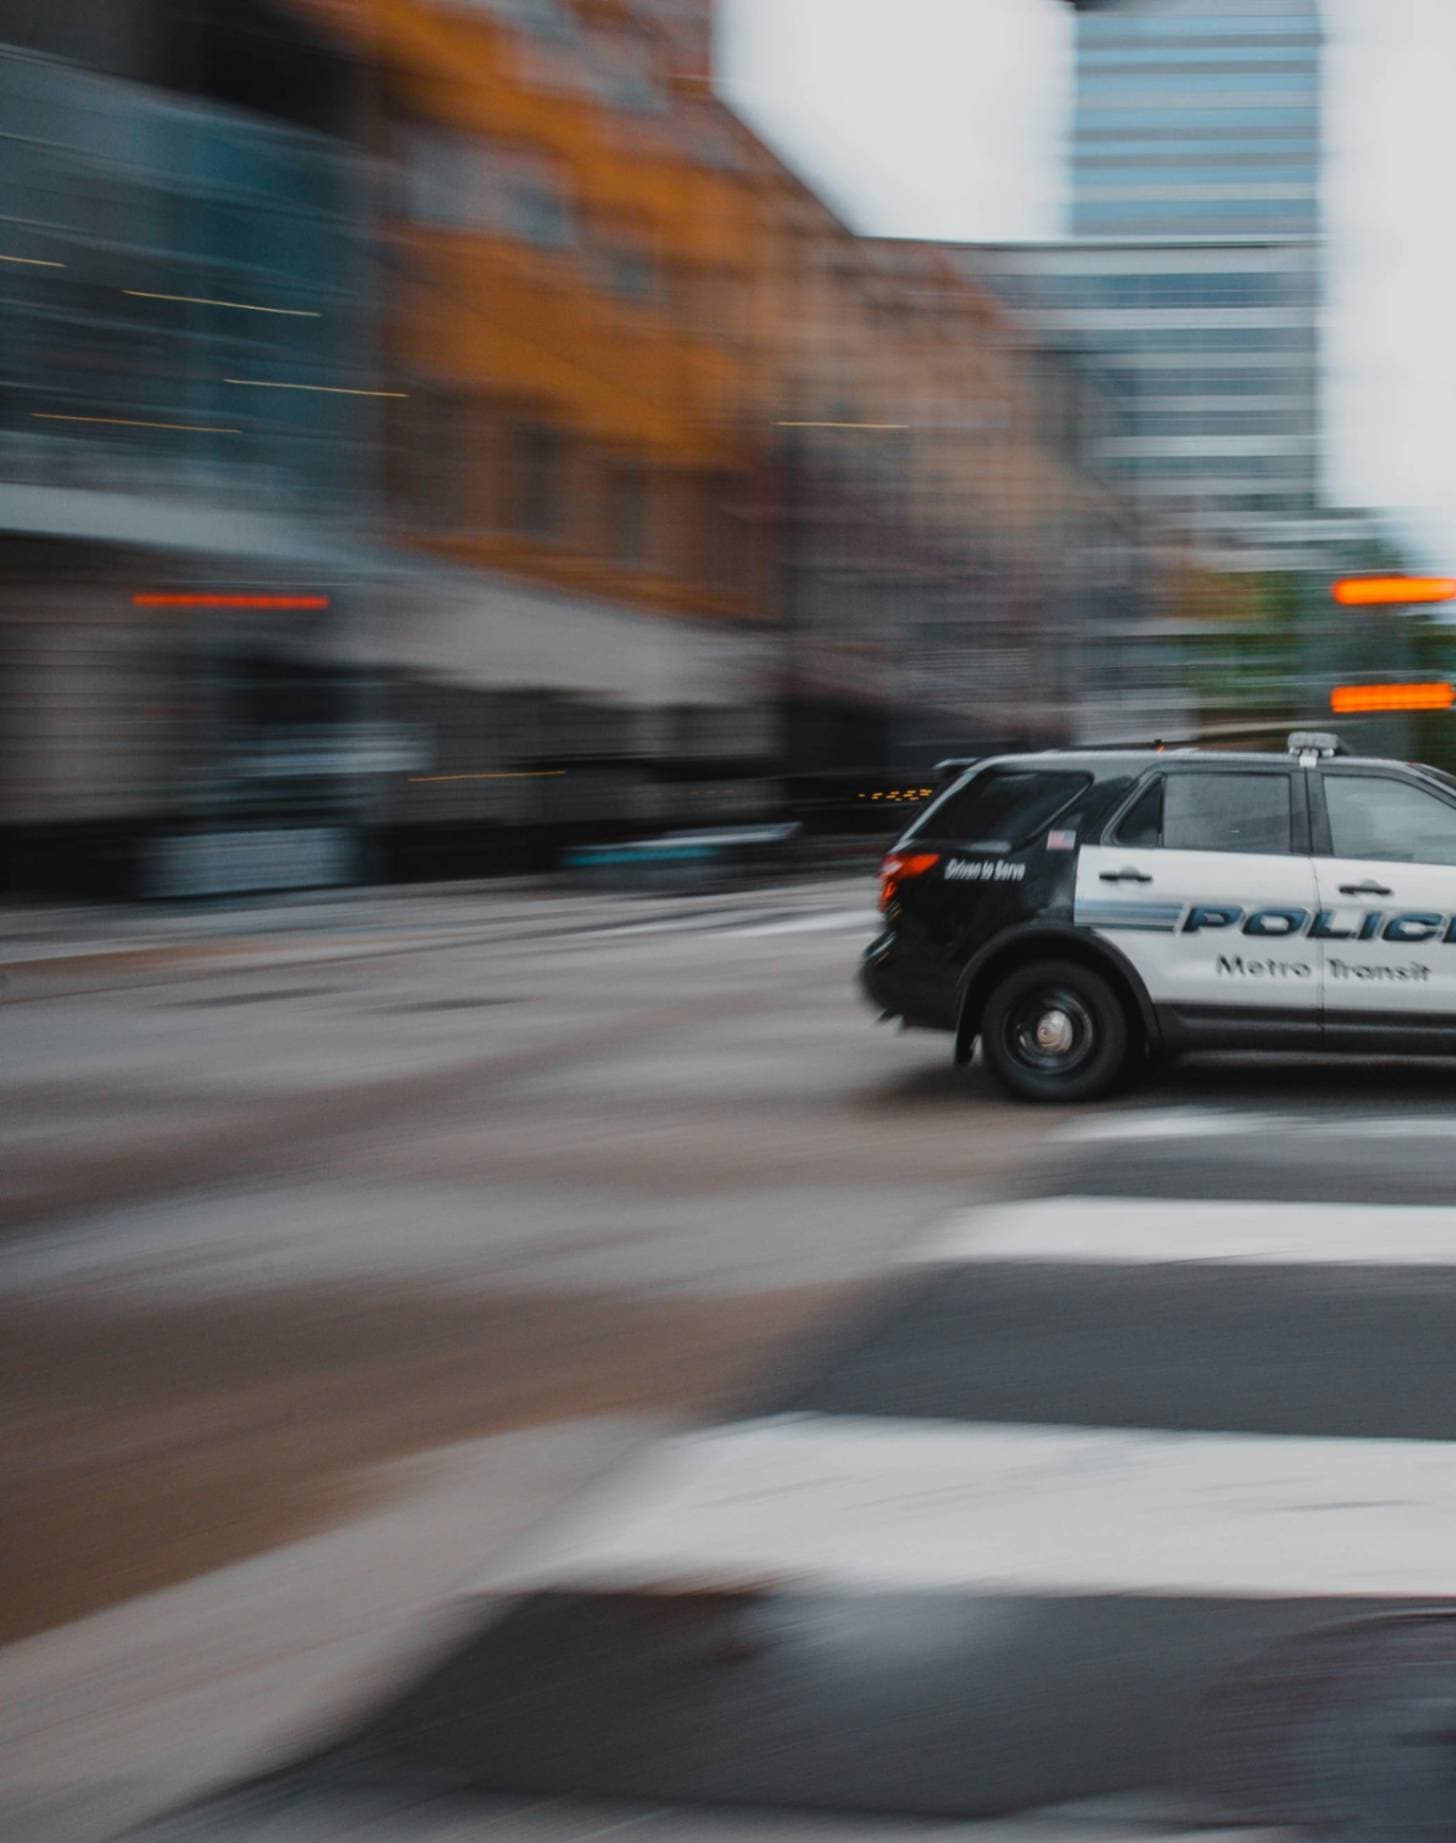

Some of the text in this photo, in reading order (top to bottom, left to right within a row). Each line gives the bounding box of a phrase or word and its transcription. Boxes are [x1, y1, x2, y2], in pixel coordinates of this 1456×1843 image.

[944, 858, 1026, 881] Driven to Serve
[1215, 953, 1432, 982] Metro Transit
